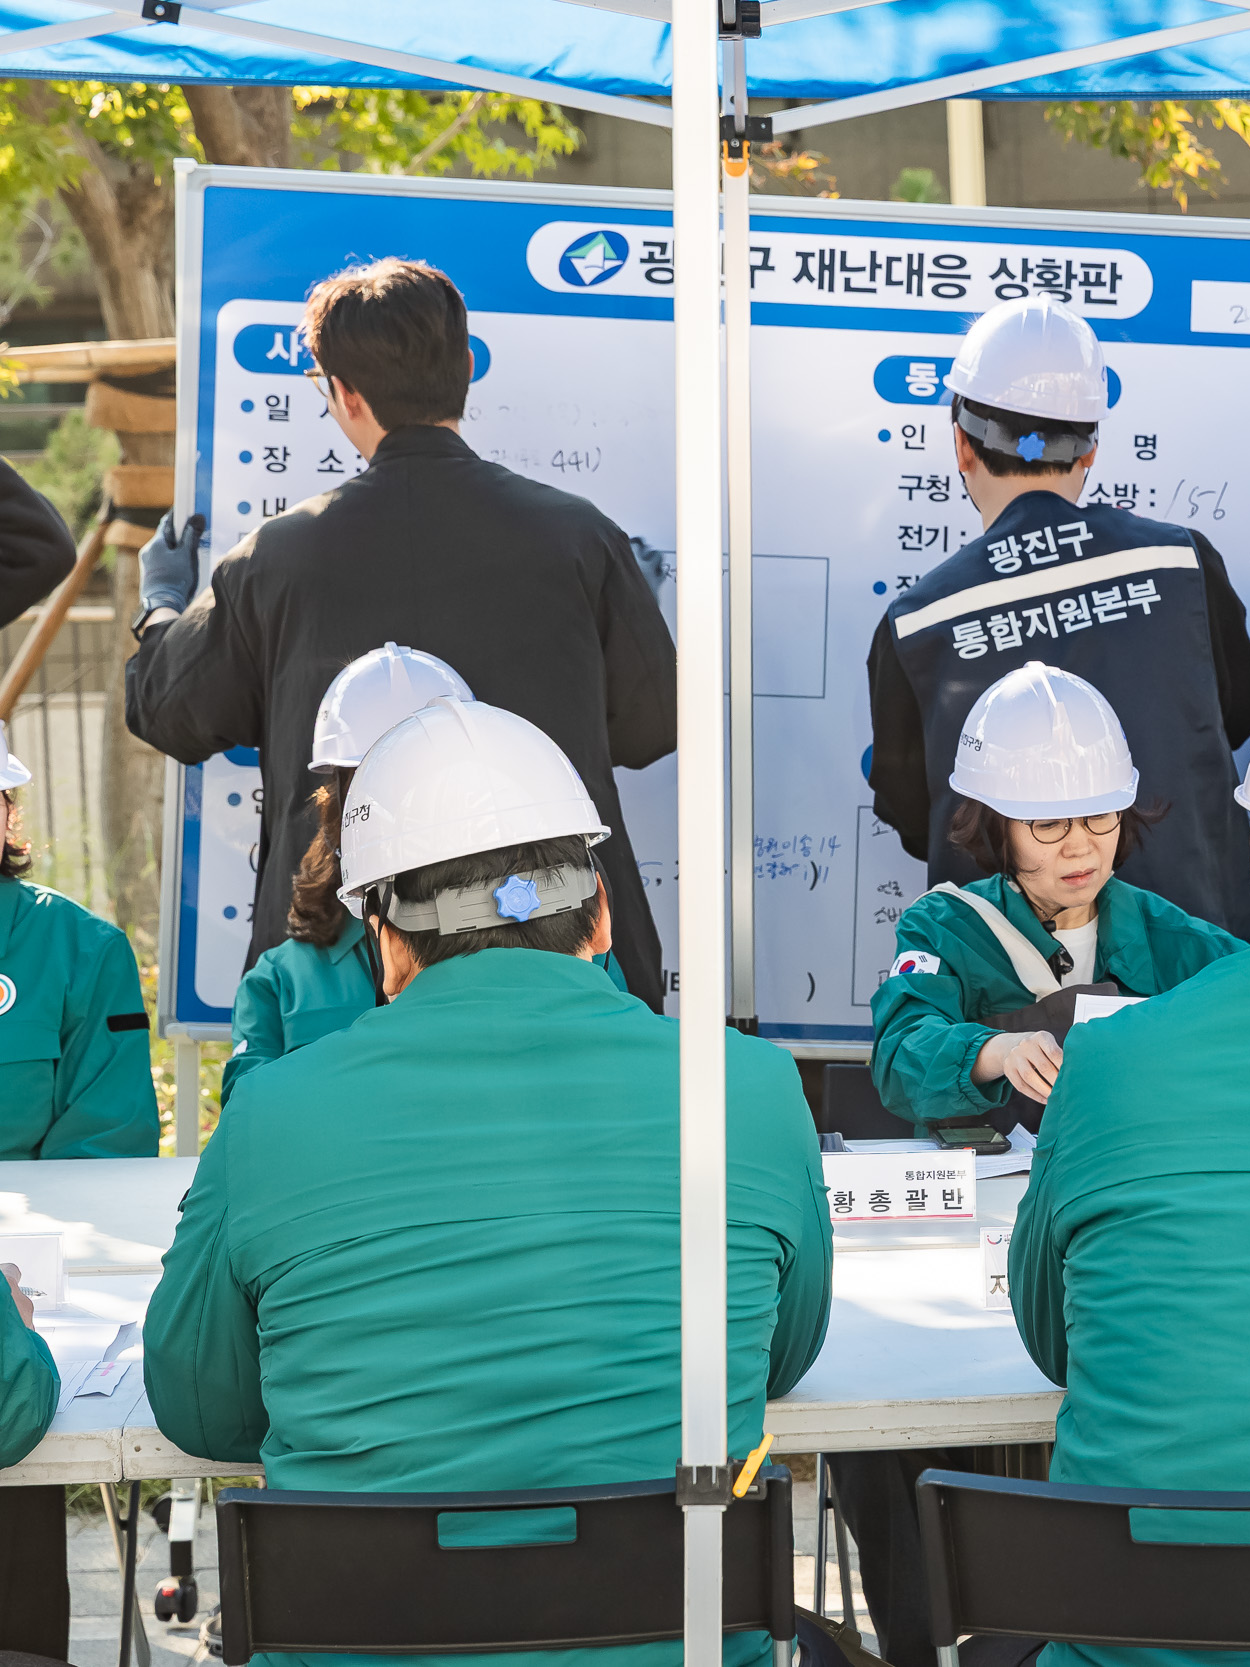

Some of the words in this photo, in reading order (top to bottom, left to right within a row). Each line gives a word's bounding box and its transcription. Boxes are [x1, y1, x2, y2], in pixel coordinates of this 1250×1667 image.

[640, 240, 775, 289] 광구
[793, 248, 972, 299] 재난대응
[989, 257, 1123, 305] 상황판
[1134, 434, 1158, 461] 명
[987, 520, 1094, 575] 광진구
[952, 578, 1162, 660] 통합지원본부
[904, 1170, 968, 1182] 통합지원본부
